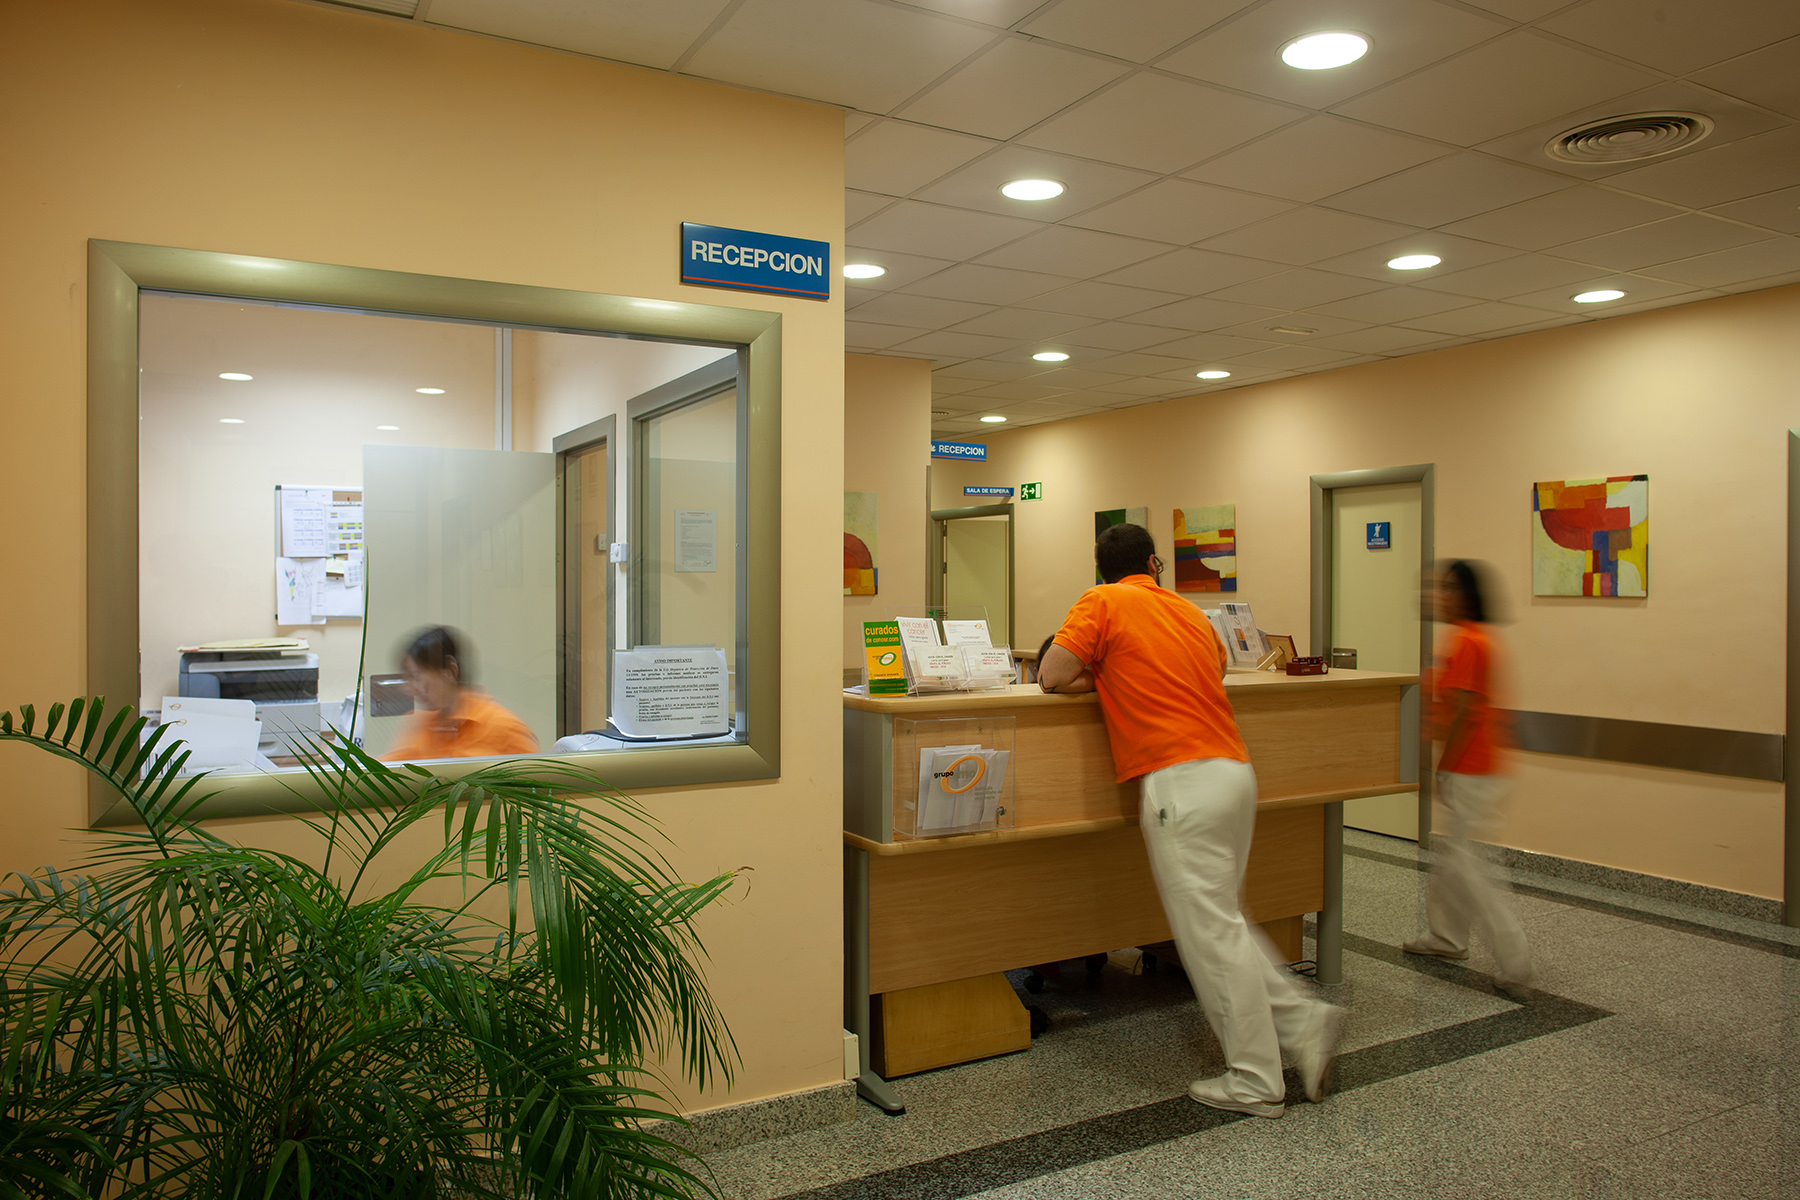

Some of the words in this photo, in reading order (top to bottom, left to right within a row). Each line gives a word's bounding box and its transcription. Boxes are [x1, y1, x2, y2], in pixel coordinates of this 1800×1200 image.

[691, 240, 822, 276] RECEPCION
[938, 444, 984, 456] RECEPCION
[865, 625, 899, 635] curados
